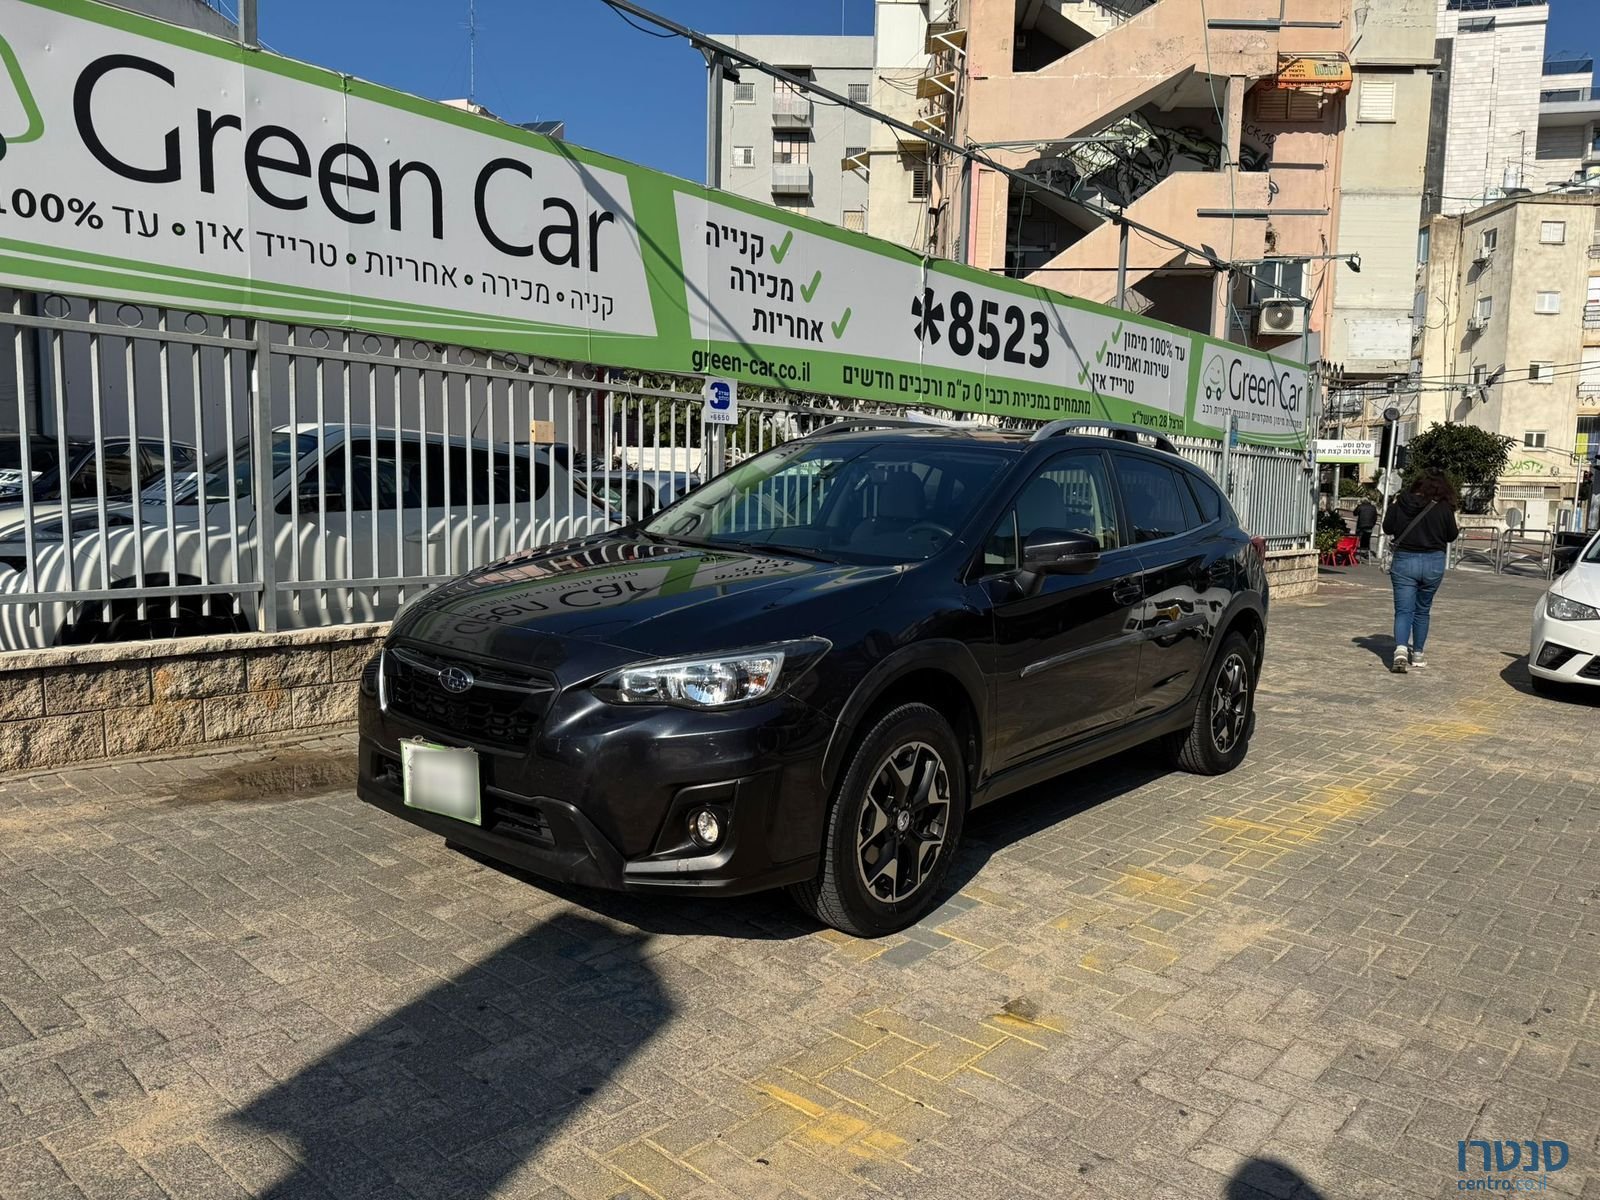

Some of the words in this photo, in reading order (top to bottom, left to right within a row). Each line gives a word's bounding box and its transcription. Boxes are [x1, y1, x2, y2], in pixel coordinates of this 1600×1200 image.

[73, 53, 443, 240] Green
[474, 157, 614, 273] Car
[0, 188, 104, 229] 00%
[112, 205, 159, 238] עד
[195, 220, 245, 254] אין
[256, 231, 338, 267] טרייד
[706, 221, 764, 265] קנייה
[364, 251, 458, 288] אחריות
[482, 272, 550, 304] מכירה
[730, 266, 794, 302] מכירה
[571, 289, 614, 321] קניה
[752, 308, 824, 343] אחריות
[1124, 332, 1147, 352] מימון
[1150, 337, 1173, 358] 100%
[1175, 346, 1185, 361] עד
[692, 350, 811, 382] green-car.co.il
[1106, 351, 1141, 373] ואמינות
[1143, 360, 1169, 378] שירות
[843, 365, 894, 390] חדשים
[900, 374, 942, 397] ורכבים
[1092, 372, 1106, 394] אין
[1110, 376, 1134, 394] טרייד
[1229, 358, 1276, 408] Green
[1279, 371, 1303, 413] Car
[974, 383, 982, 401] 0
[985, 387, 1010, 406] רכבי
[1013, 391, 1050, 411] במכירת
[1053, 396, 1091, 415] מתמחים
[1160, 414, 1168, 428] 28
[1168, 415, 1184, 430] הרצל
